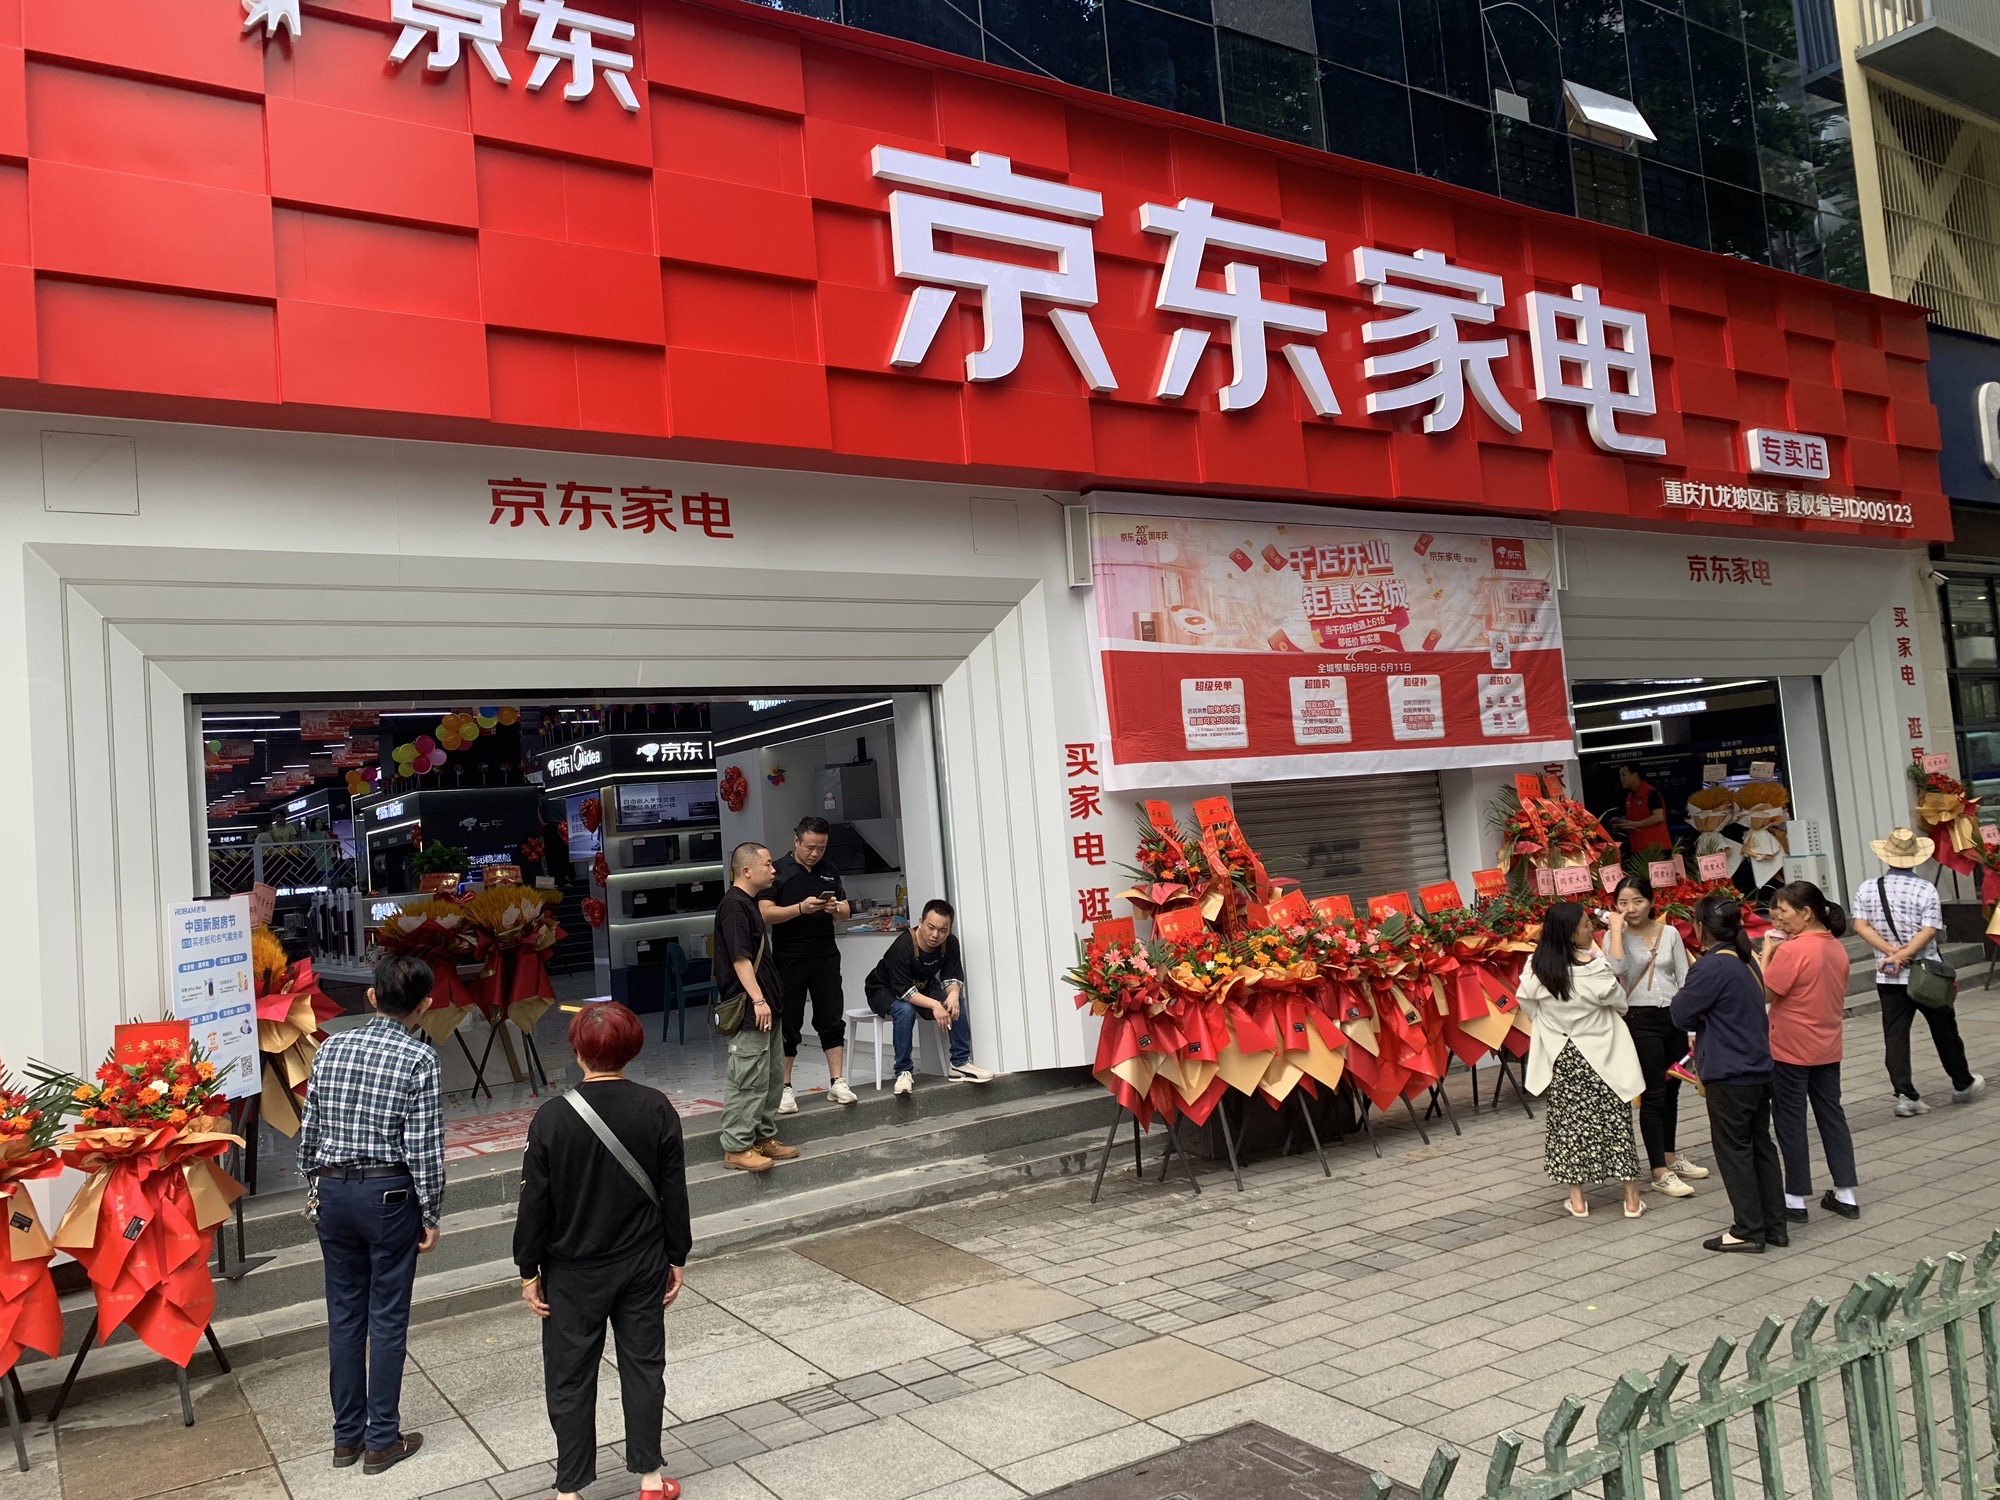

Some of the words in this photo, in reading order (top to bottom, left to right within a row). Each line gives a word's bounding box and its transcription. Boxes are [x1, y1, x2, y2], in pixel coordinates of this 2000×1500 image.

[388, 0, 641, 113] 京东
[870, 144, 1667, 456] 京东家电
[1761, 435, 1825, 471] 专卖店
[487, 477, 735, 539] 京东家电
[1664, 480, 1779, 514] 重庆九龙坡区店
[1785, 492, 1913, 525] 授权编号JD909123
[1120, 532, 1135, 542] 京东
[1136, 536, 1148, 546] 618
[1148, 531, 1169, 541] 周年庆
[1288, 539, 1393, 577] 千店开业
[1429, 551, 1462, 563] 京东家电
[1507, 549, 1522, 560] 京东
[1686, 554, 1773, 587] 京东家电
[1302, 579, 1410, 617] 钜惠全城
[1325, 616, 1385, 635] 当千店开业遇上618
[1337, 636, 1359, 648] 够低价
[1360, 633, 1381, 645] 购实惠
[1317, 663, 1412, 674] 全城聚焦6月9日-6月11日
[1195, 680, 1232, 691] 超级免单
[1304, 678, 1330, 689] 超值购
[1403, 677, 1427, 687] 超级补
[1490, 675, 1511, 685] 超放心
[1893, 607, 1916, 686] 买家电
[1908, 716, 1926, 768] 逛京
[1189, 715, 1240, 726] 最高可免5000元
[554, 756, 571, 775] 京东
[573, 745, 602, 771] Midea
[660, 741, 703, 762] 京东
[1064, 742, 1107, 866] 买家电
[185, 914, 236, 934] 中国新厨房节
